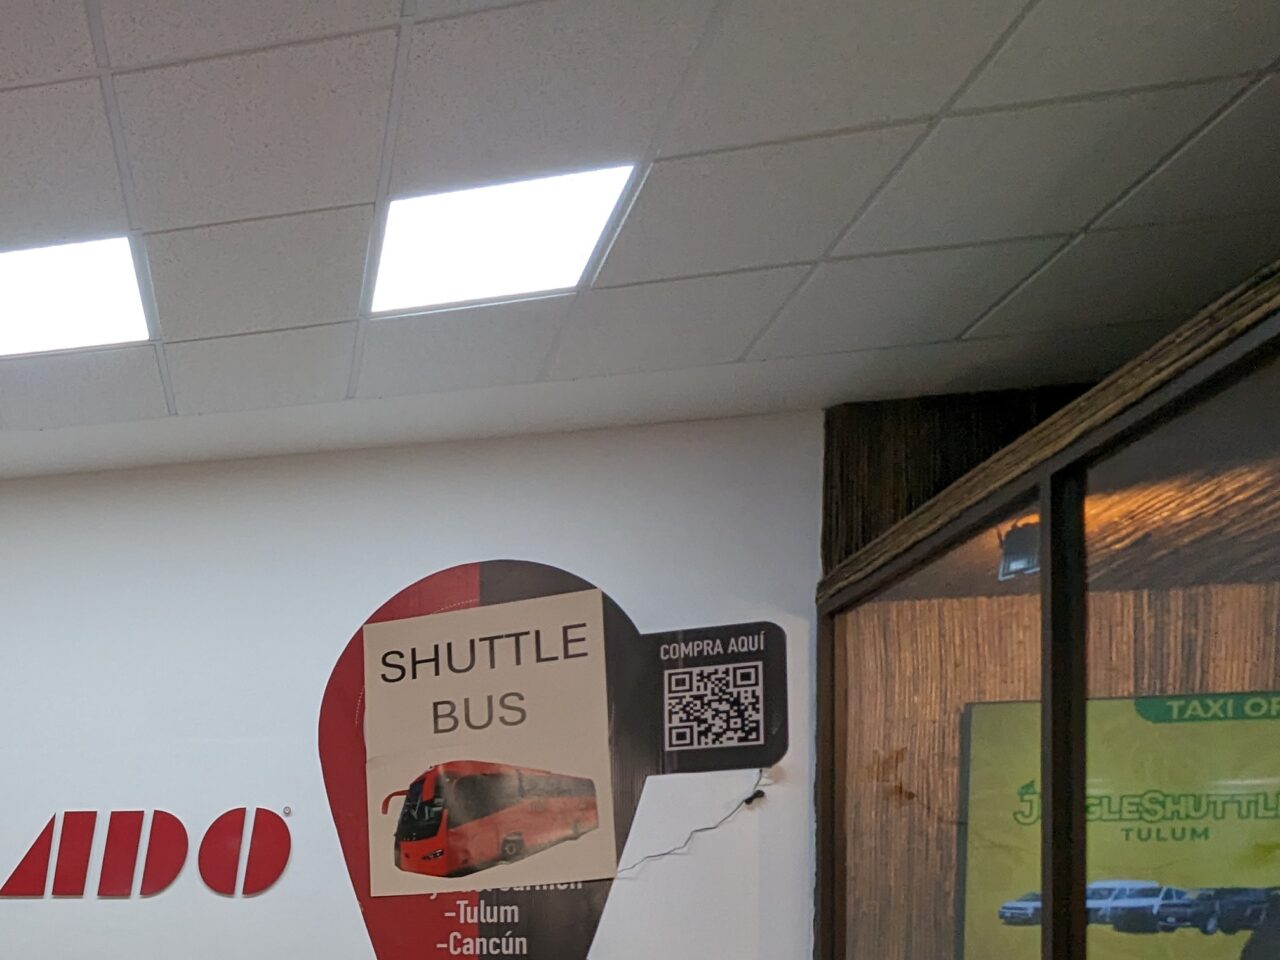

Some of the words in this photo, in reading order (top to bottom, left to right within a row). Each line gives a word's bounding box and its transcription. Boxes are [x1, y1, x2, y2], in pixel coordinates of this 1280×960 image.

[380, 623, 589, 683] SHUTTLE
[660, 639, 724, 660] COMPRA
[728, 630, 766, 653] AQUÍ
[432, 691, 527, 735] BUS
[1166, 698, 1233, 719] TAXI
[1121, 827, 1210, 843] TULUM
[444, 899, 519, 924] -Tulum
[436, 930, 528, 955] -Cancún
